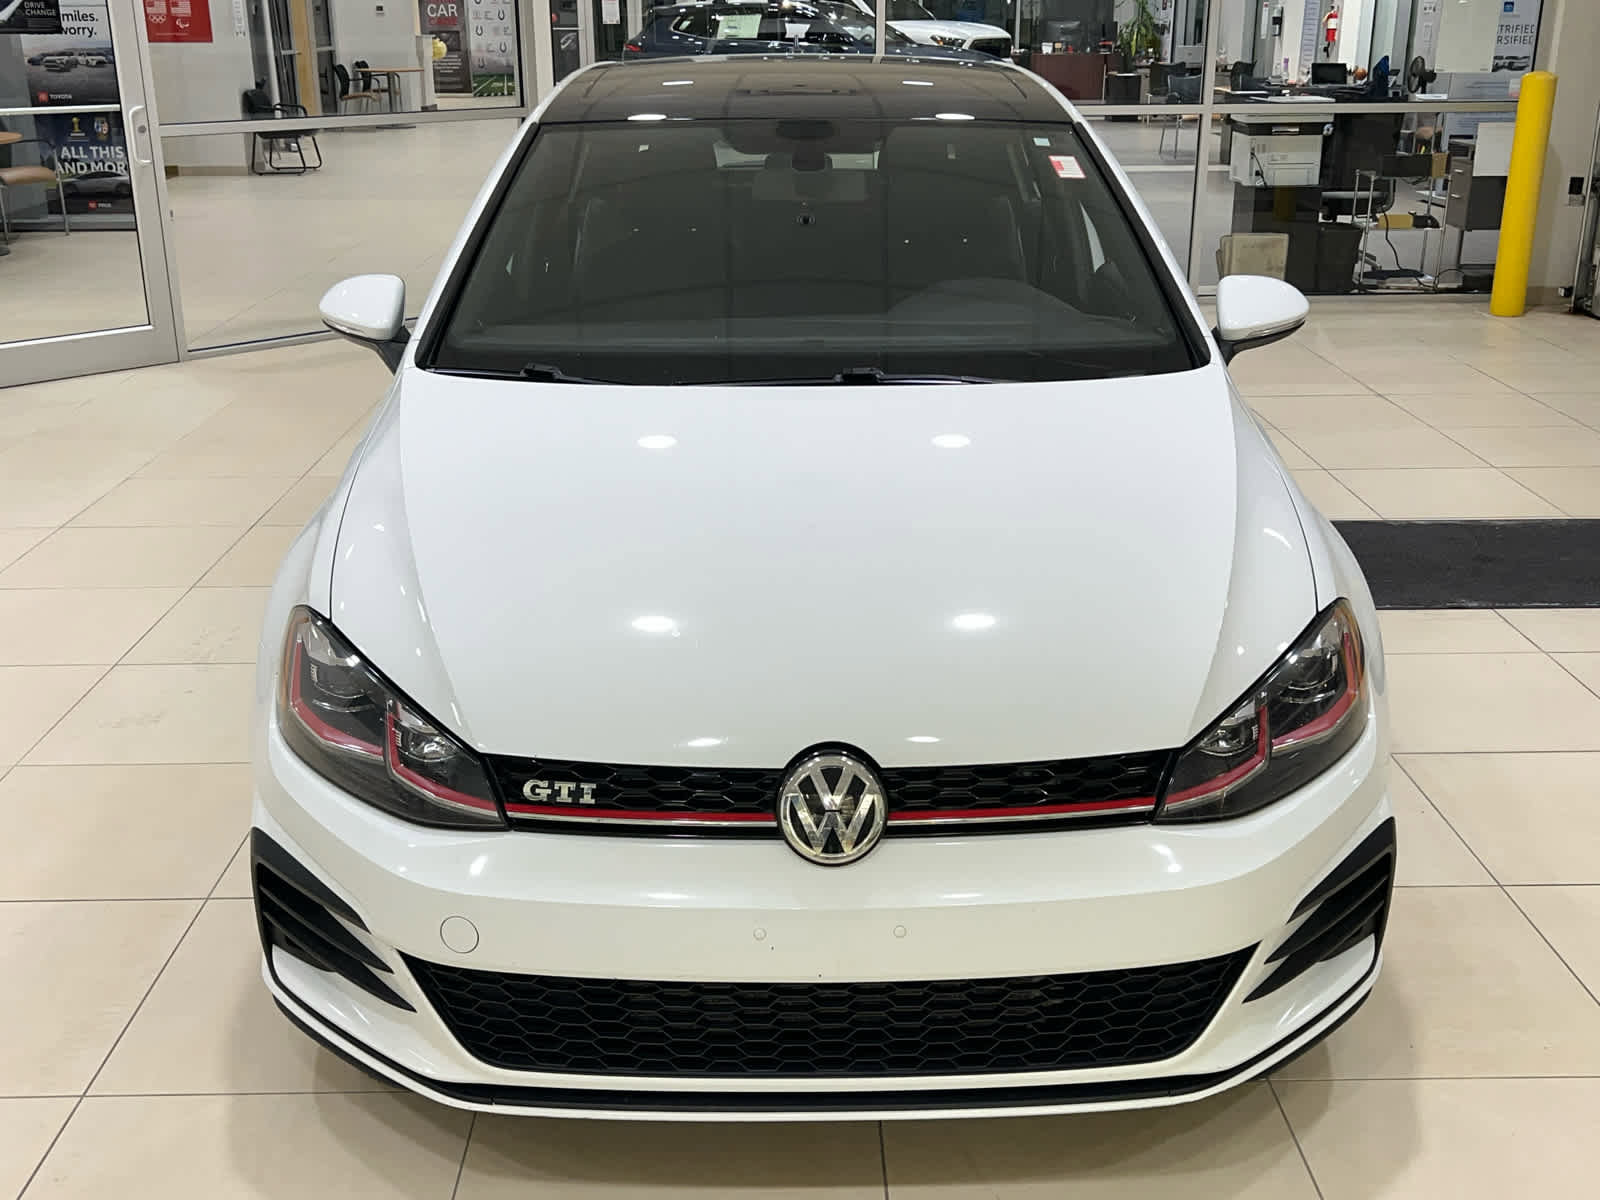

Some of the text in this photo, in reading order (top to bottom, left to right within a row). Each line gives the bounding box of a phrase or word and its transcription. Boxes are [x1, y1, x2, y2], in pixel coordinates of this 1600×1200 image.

[61, 10, 99, 22] miles.
[427, 3, 458, 17] CAR
[61, 146, 124, 159] ALL THIS
[56, 161, 128, 176] AND MOR
[522, 779, 598, 804] GTI
[783, 757, 883, 861] VW
